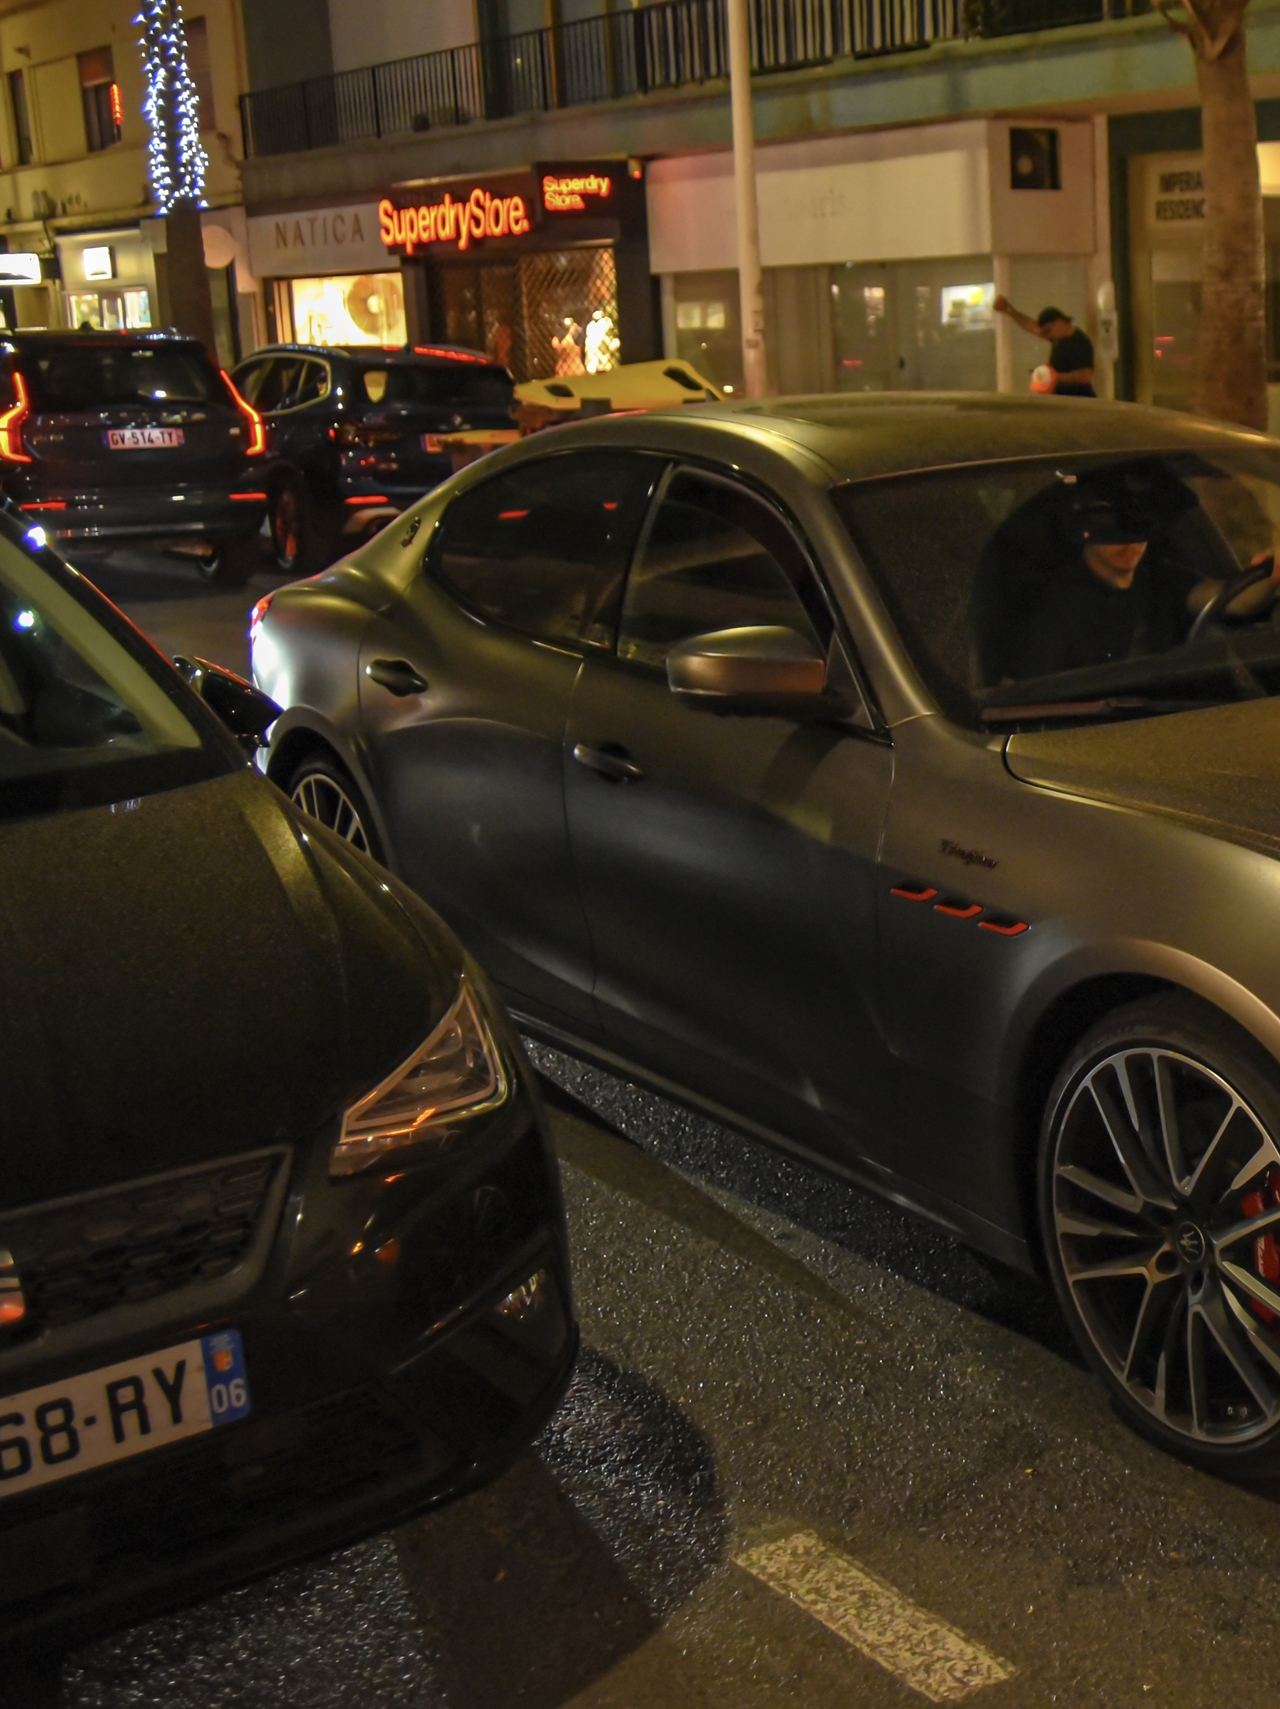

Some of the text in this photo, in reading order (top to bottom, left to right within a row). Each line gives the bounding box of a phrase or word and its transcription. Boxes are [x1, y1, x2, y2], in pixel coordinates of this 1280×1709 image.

[542, 174, 611, 197] Superdry
[1159, 171, 1204, 193] IMPERIA
[1155, 199, 1206, 219] RESIDENC
[275, 212, 365, 249] NATICA
[110, 430, 175, 446] GV-514-TY
[210, 1378, 248, 1414] 06
